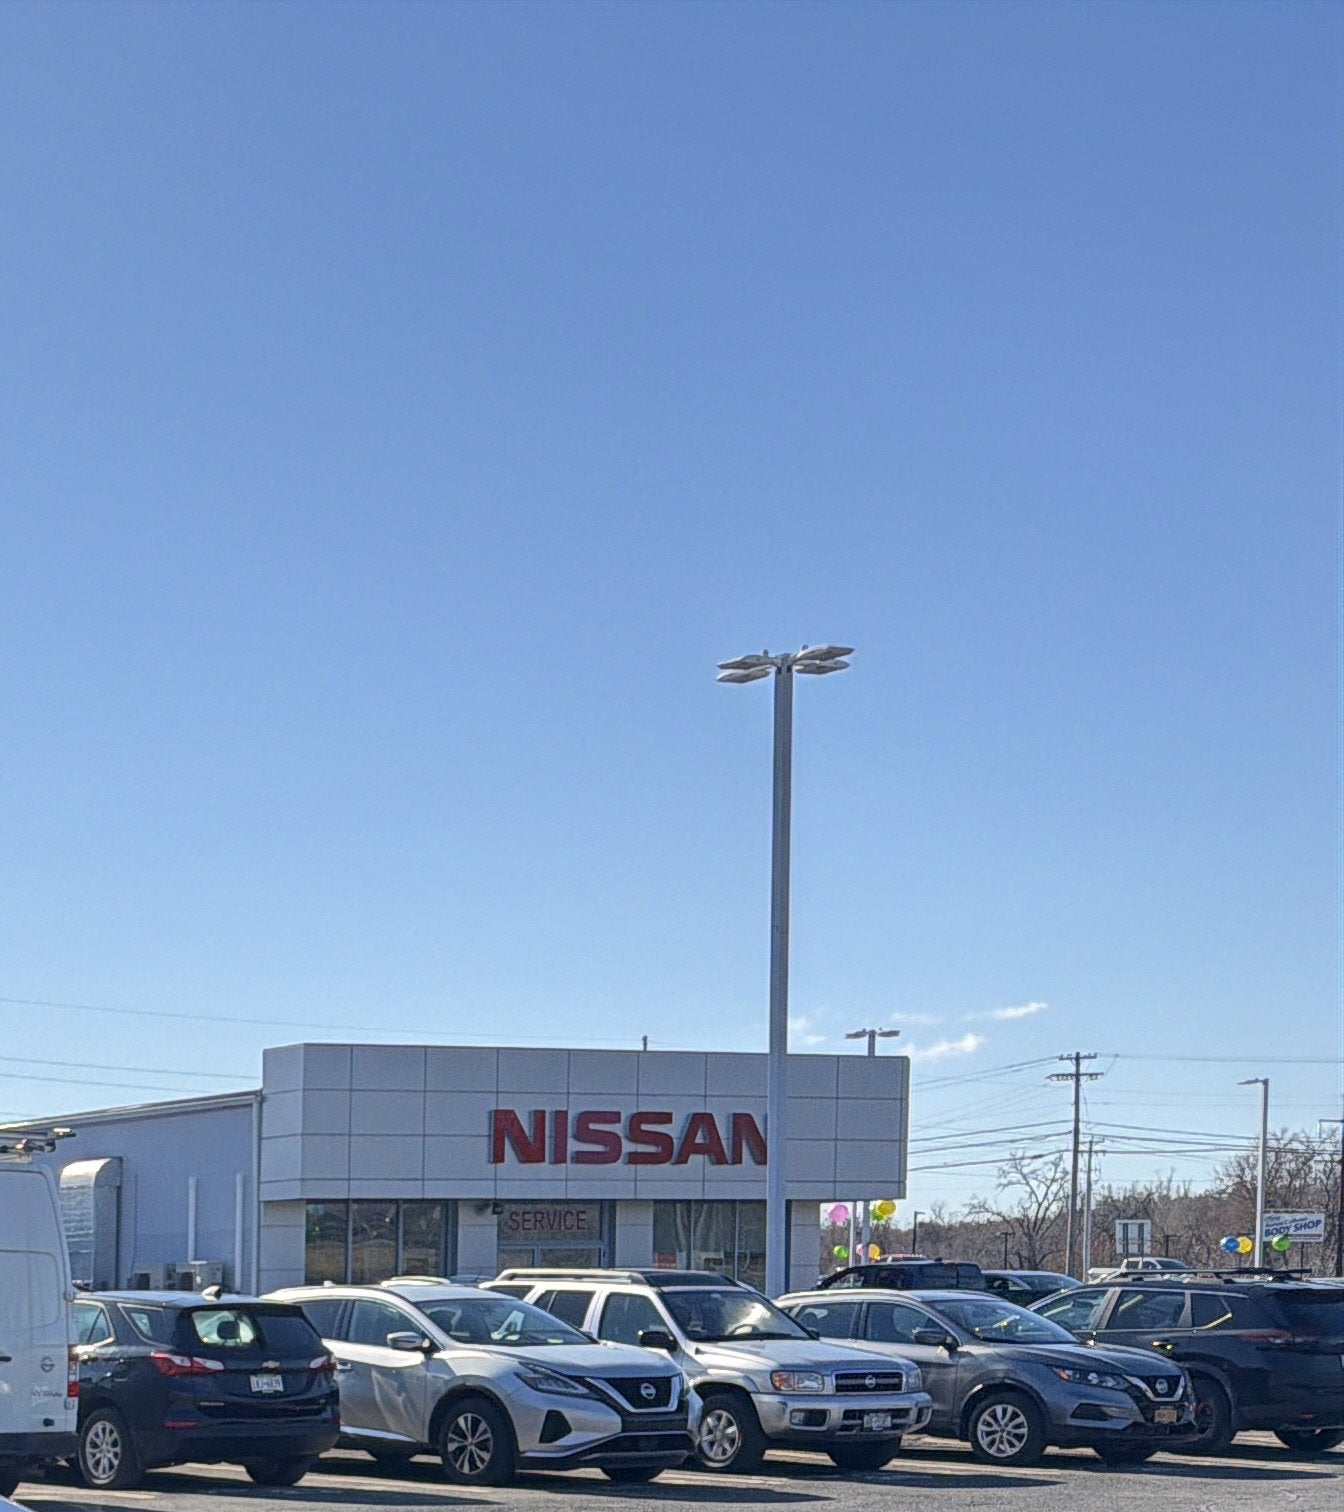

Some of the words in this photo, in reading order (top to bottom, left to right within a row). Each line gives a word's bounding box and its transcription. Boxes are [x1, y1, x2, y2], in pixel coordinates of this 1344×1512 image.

[490, 1109, 768, 1165] NISSAN
[509, 1210, 586, 1231] SERVICE
[1265, 1225, 1292, 1238] BODY
[1293, 1219, 1322, 1233] SHOP
